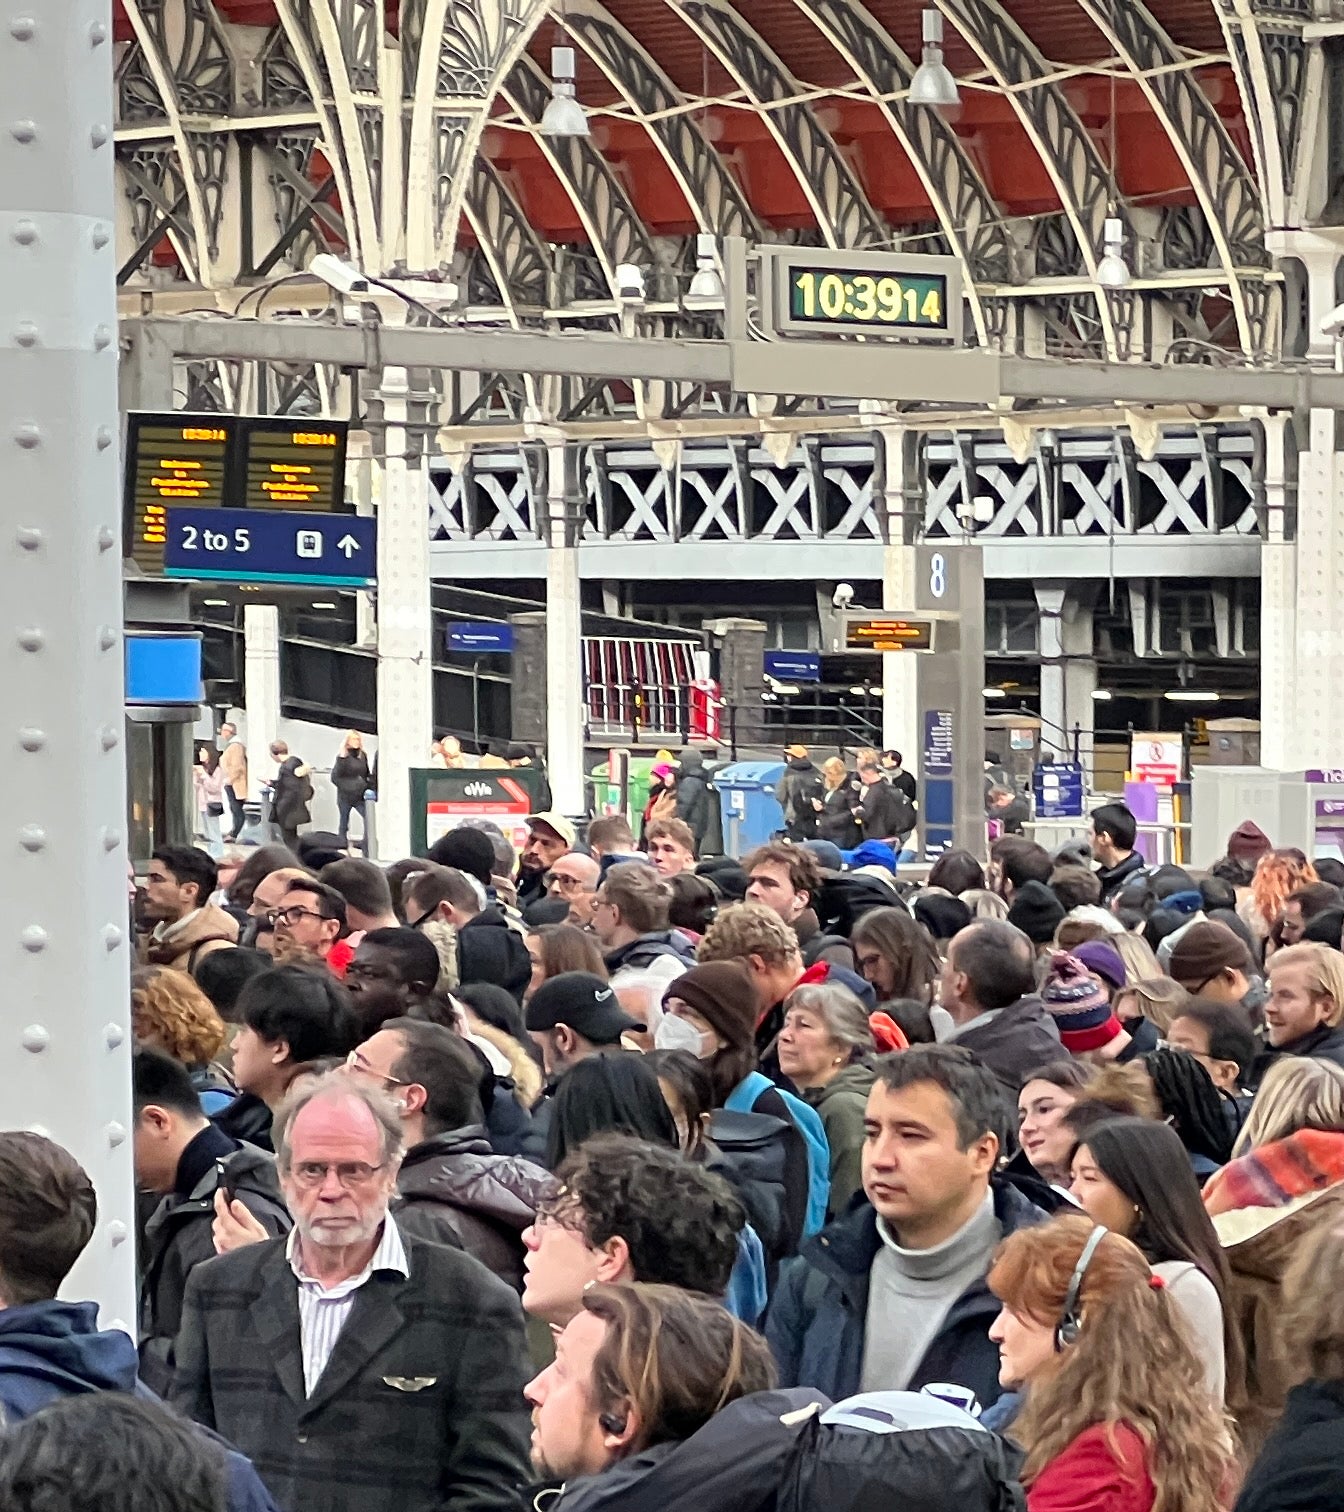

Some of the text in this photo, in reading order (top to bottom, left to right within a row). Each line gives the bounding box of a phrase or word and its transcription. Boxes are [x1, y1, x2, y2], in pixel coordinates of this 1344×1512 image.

[182, 526, 250, 552] 2 to 5
[930, 552, 946, 598] 8
